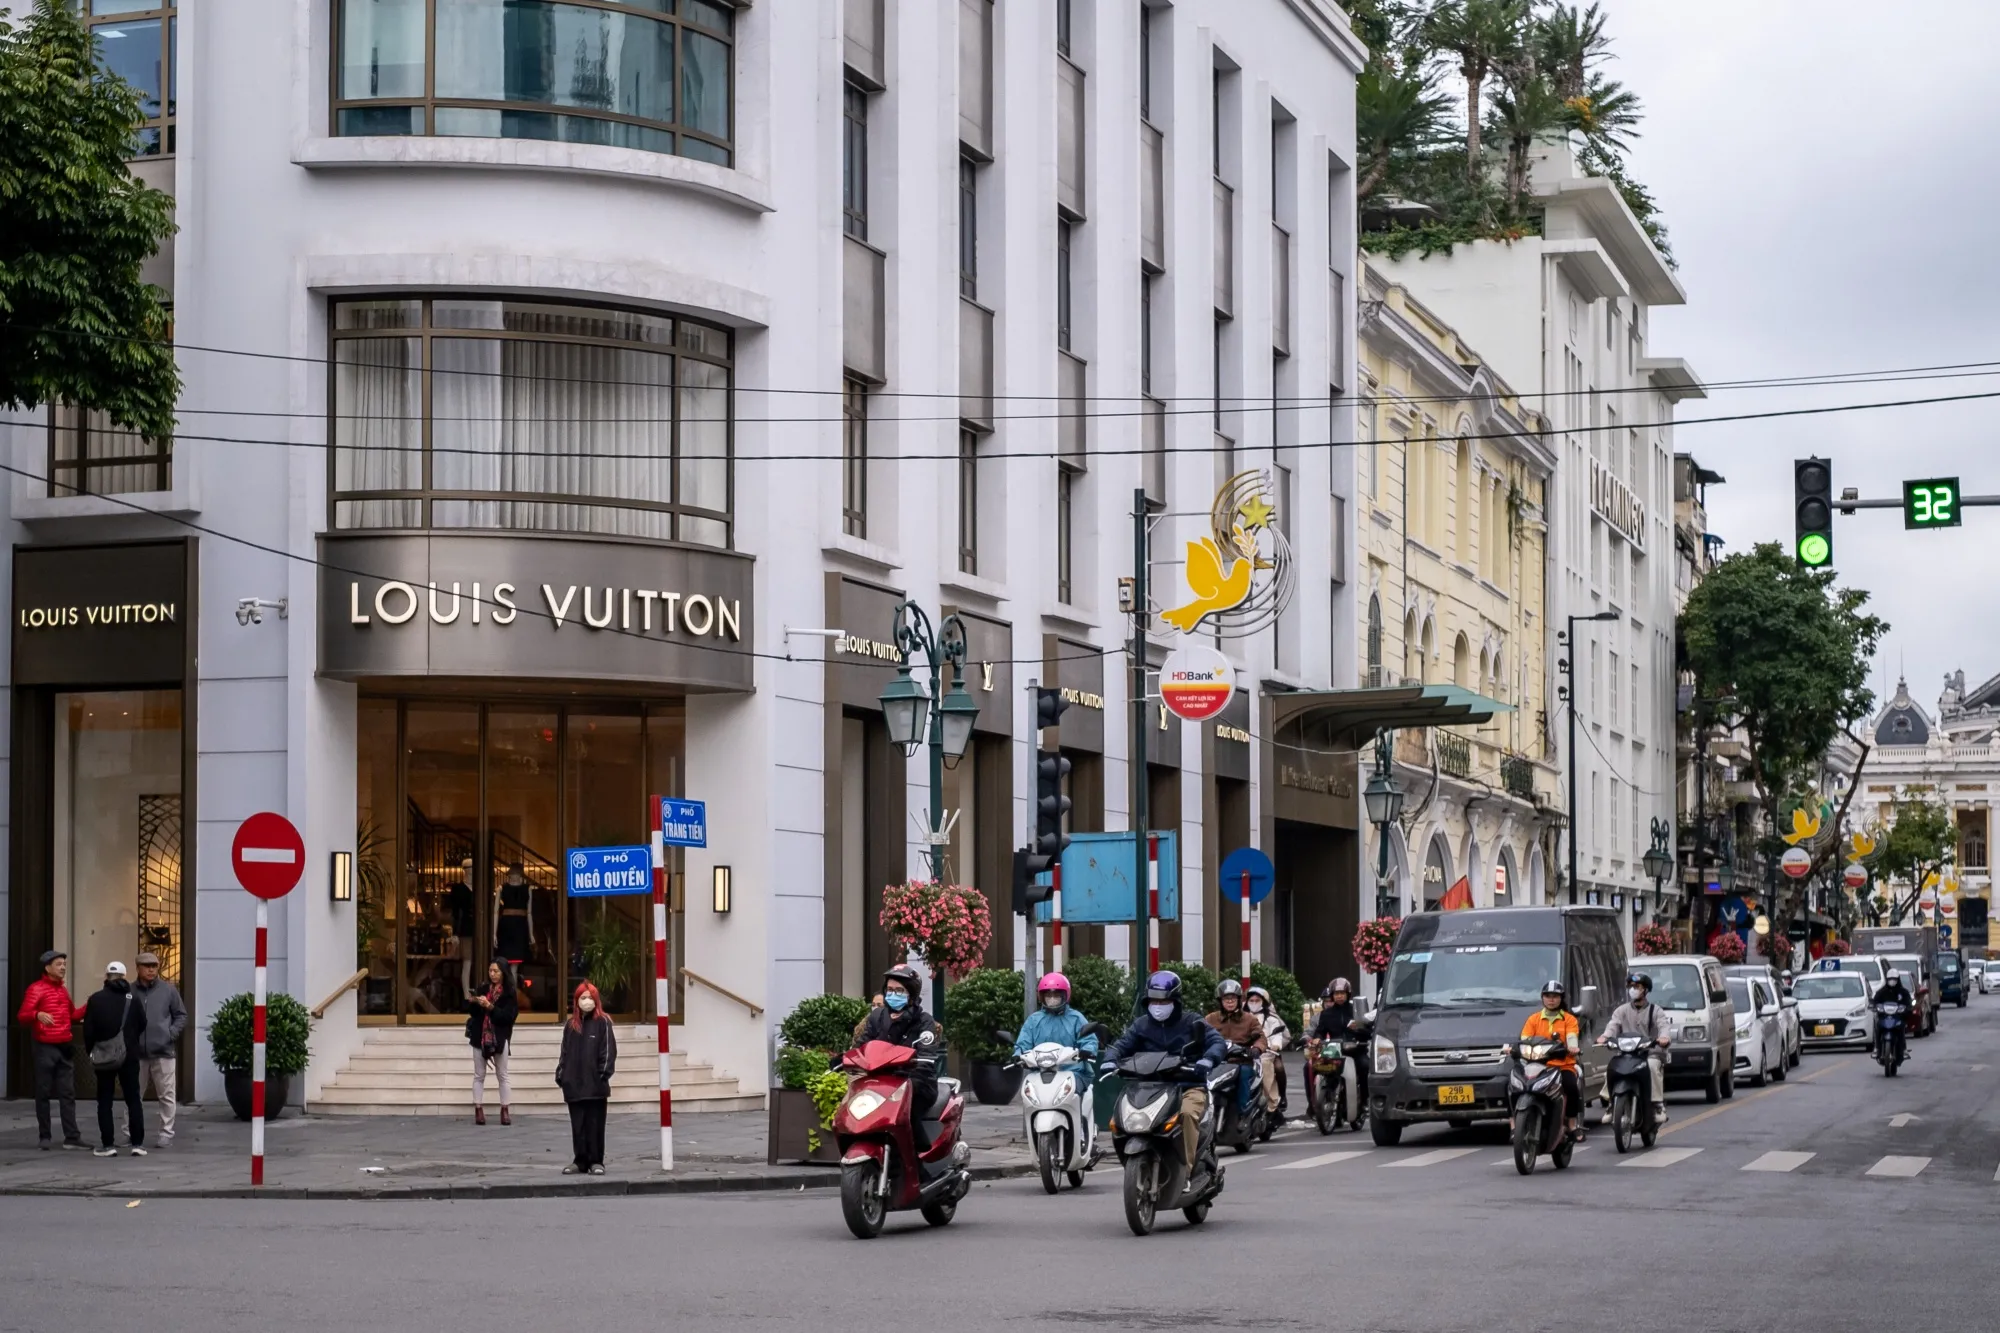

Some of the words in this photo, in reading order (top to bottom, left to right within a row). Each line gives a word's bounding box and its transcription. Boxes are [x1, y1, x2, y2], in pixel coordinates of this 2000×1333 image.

[1913, 487, 1952, 521] 32
[21, 606, 79, 628] LOUIS
[86, 602, 176, 625] VUITTON
[351, 580, 517, 626] LOUIS
[540, 583, 741, 643] VUITTON
[846, 635, 871, 656] LOUIS
[1171, 671, 1214, 681] HDBank
[1080, 690, 1104, 709] VUITTON
[680, 805, 695, 817] PHỐ
[664, 819, 688, 840] TRÀNG
[603, 851, 629, 864] PHỐ
[575, 869, 600, 889] NGÔ
